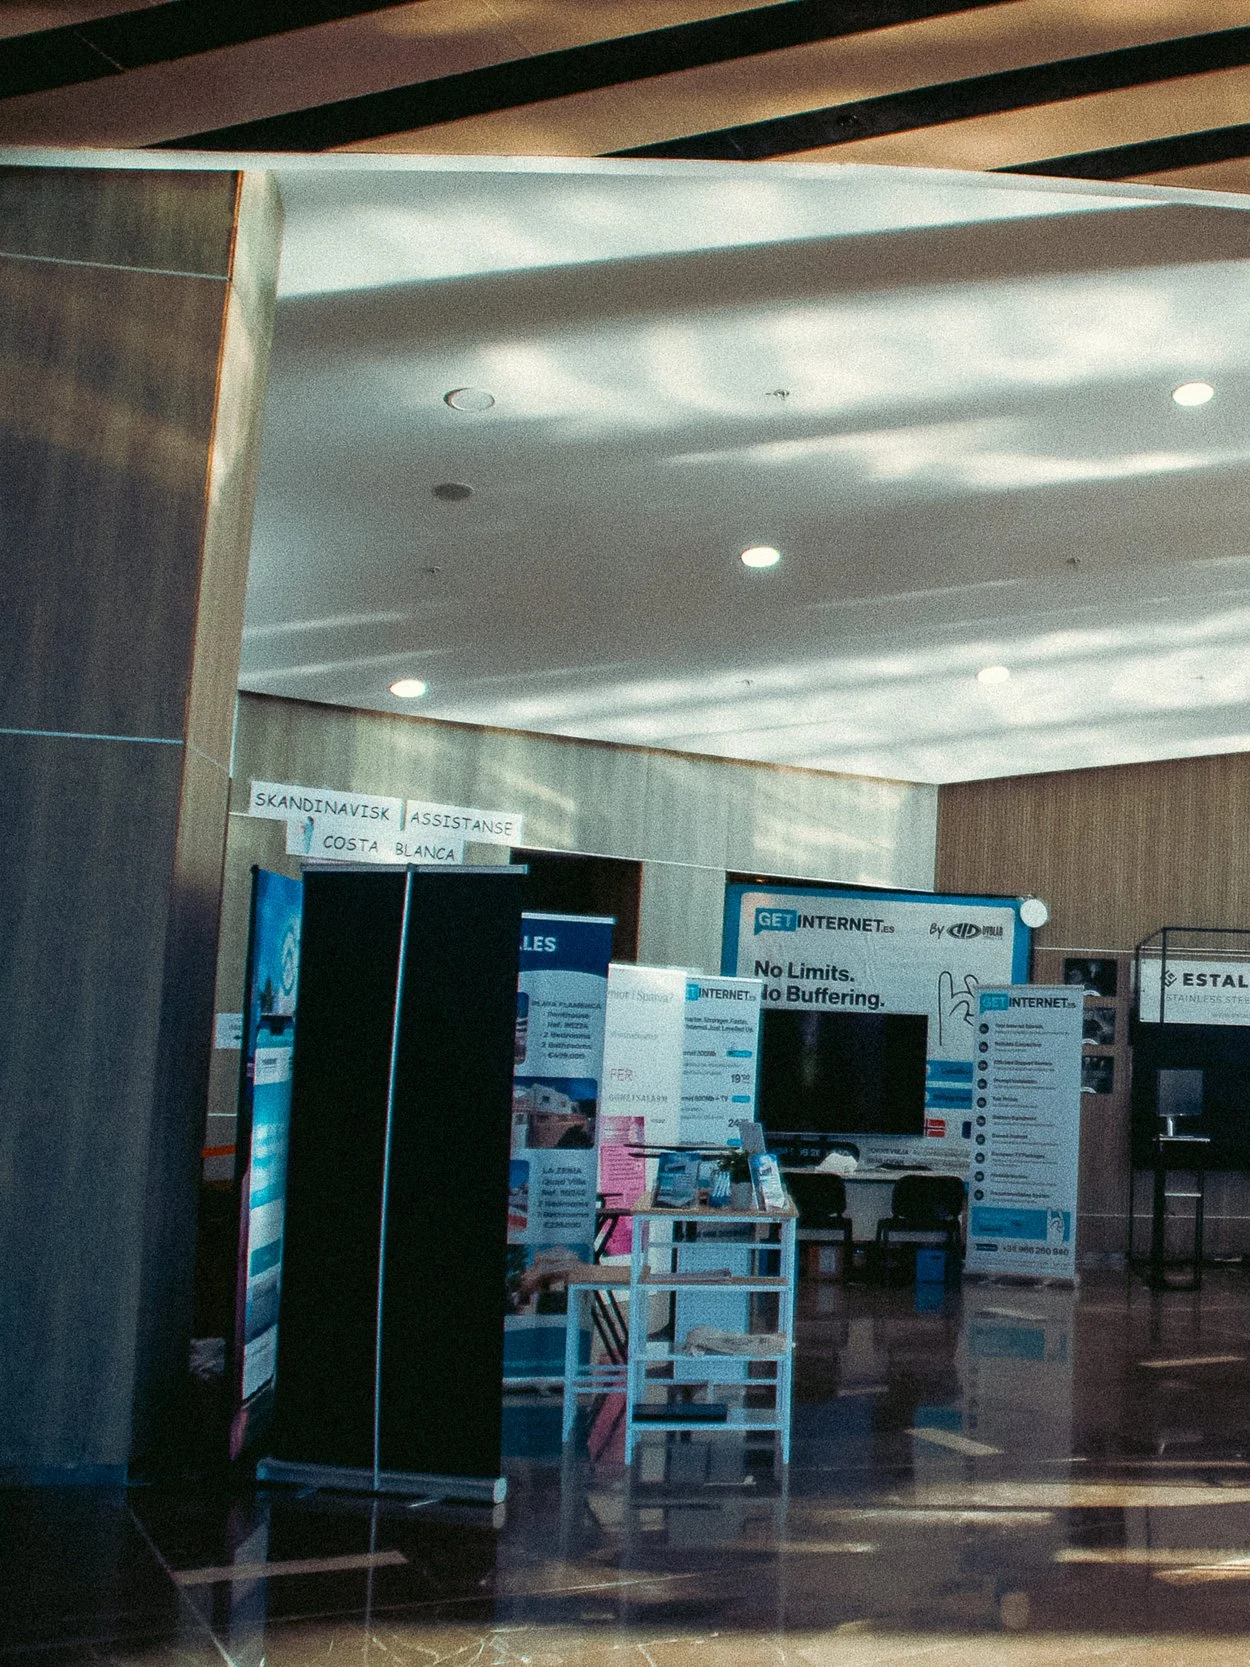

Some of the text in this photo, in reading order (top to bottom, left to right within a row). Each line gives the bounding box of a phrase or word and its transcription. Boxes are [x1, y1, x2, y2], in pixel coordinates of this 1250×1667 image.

[254, 792, 513, 836] SKANDINAVISK ASSISTANSE
[323, 835, 455, 861] COSTA BLANCA
[519, 935, 557, 952] LES
[754, 960, 855, 982] No Limits.
[786, 985, 886, 1010] Buffering.
